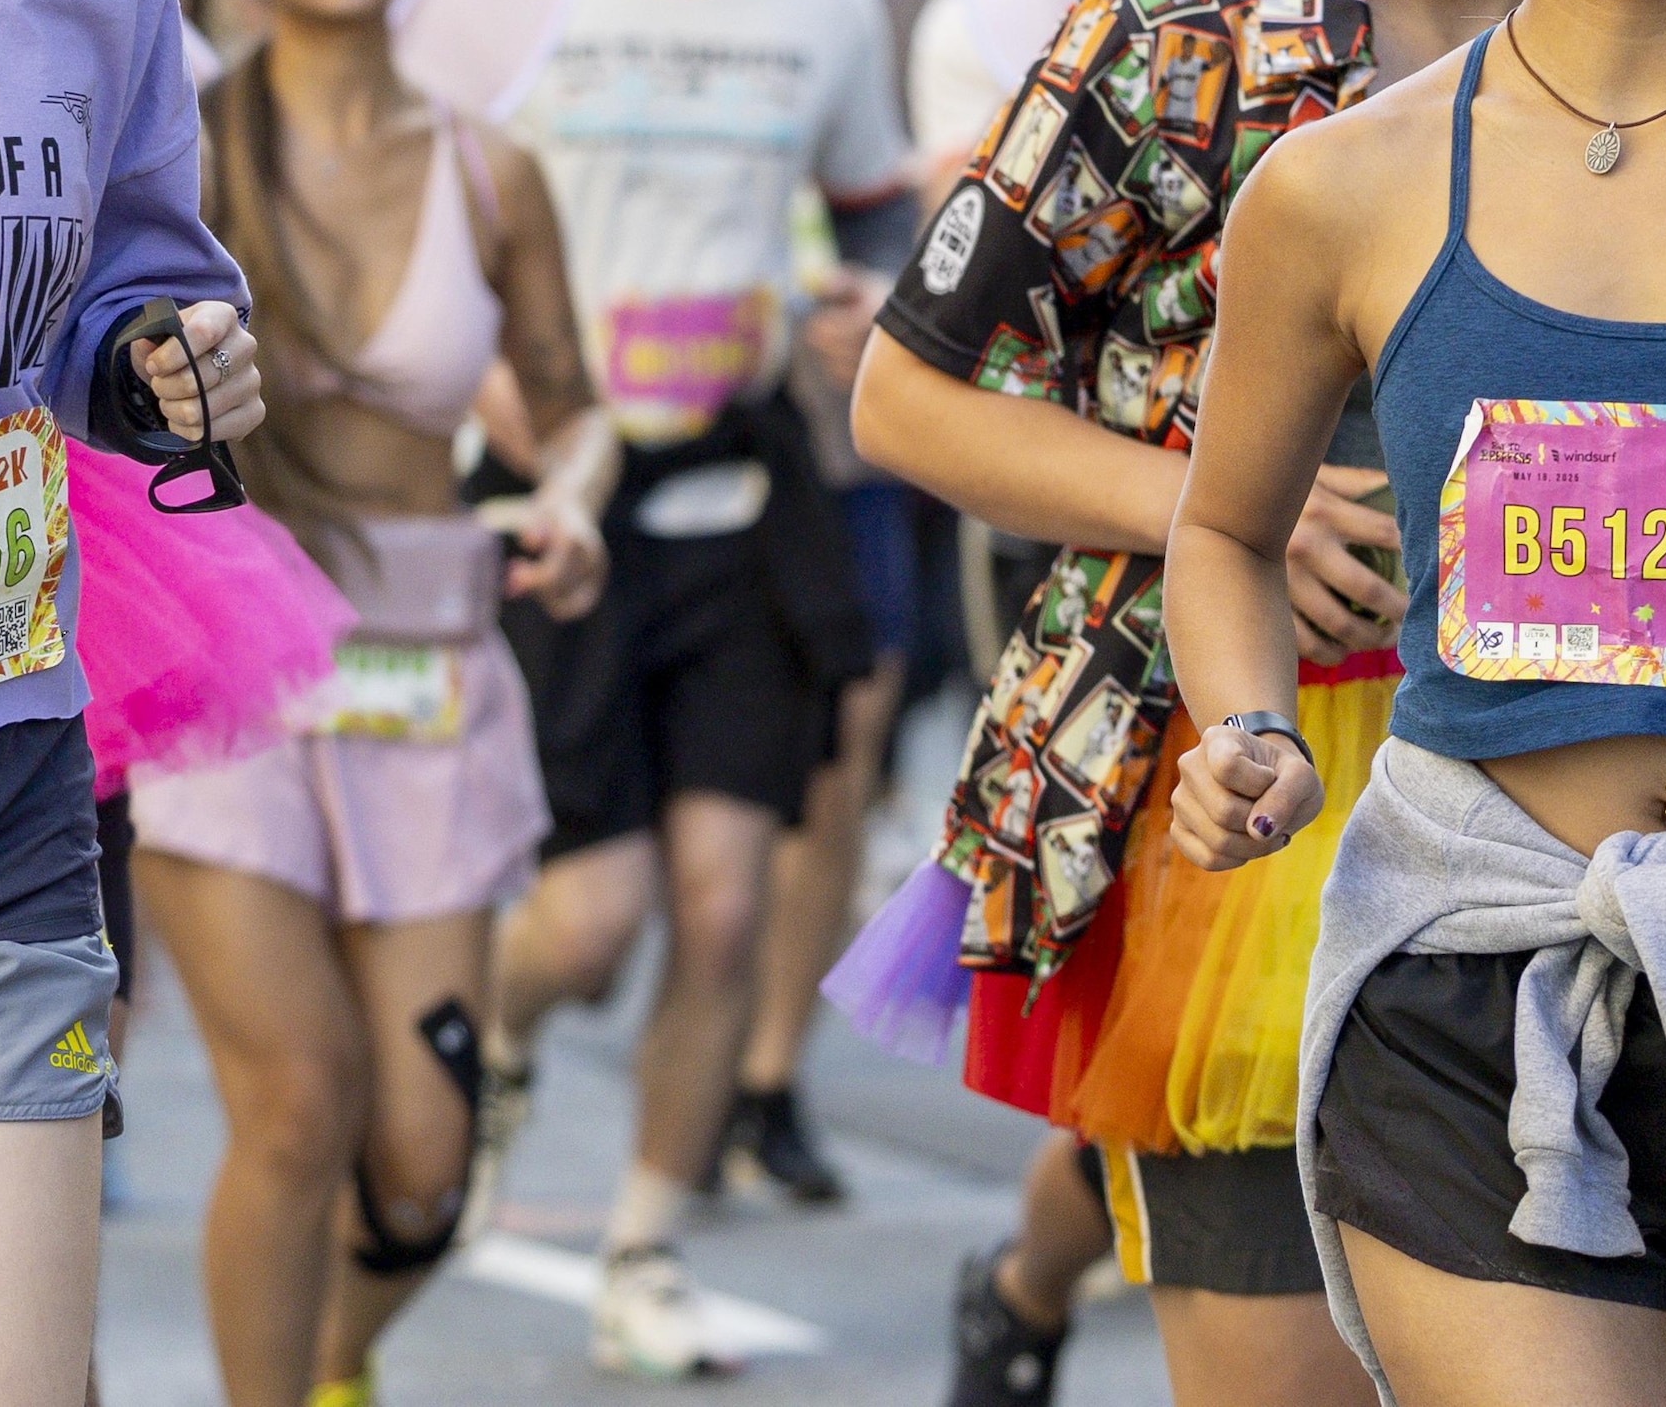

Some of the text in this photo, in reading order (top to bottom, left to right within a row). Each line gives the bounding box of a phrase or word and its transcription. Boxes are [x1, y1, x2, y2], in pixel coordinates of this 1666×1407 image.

[40, 136, 63, 198] A
[1564, 450, 1617, 463] windsurf
[1513, 472, 1533, 481] MAY
[49, 1050, 101, 1074] adidas
